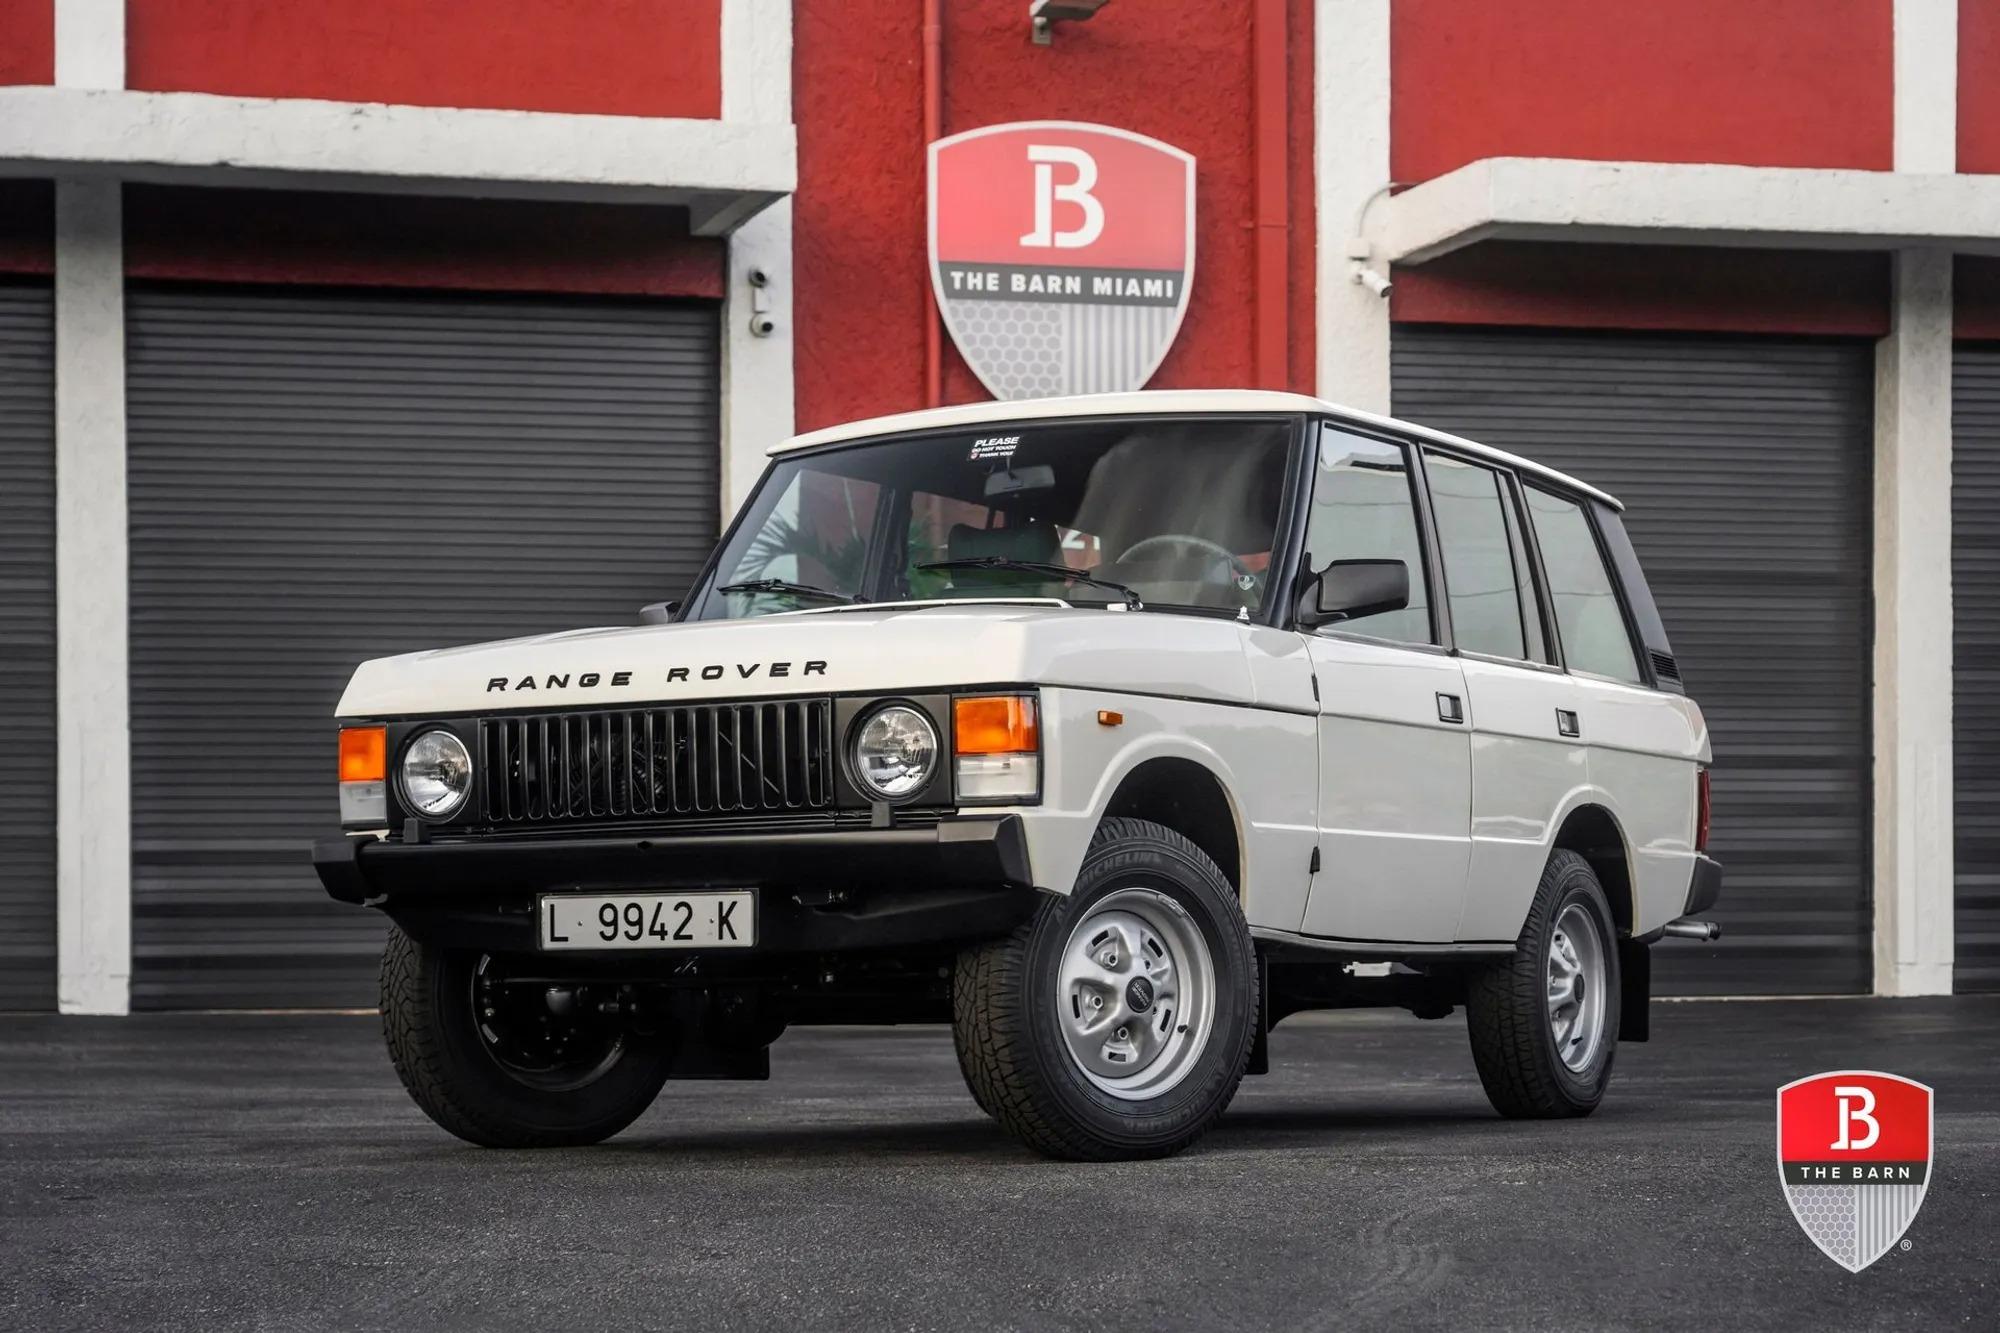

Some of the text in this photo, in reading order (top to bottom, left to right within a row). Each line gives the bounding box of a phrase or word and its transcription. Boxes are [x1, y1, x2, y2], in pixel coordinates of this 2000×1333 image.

[1019, 144, 1105, 248] B
[950, 271, 1173, 298] THE BARN MIAMI
[974, 436, 1020, 447] PLEASE
[486, 660, 827, 692] RANGE ROVER
[550, 901, 738, 942] L 9942 K
